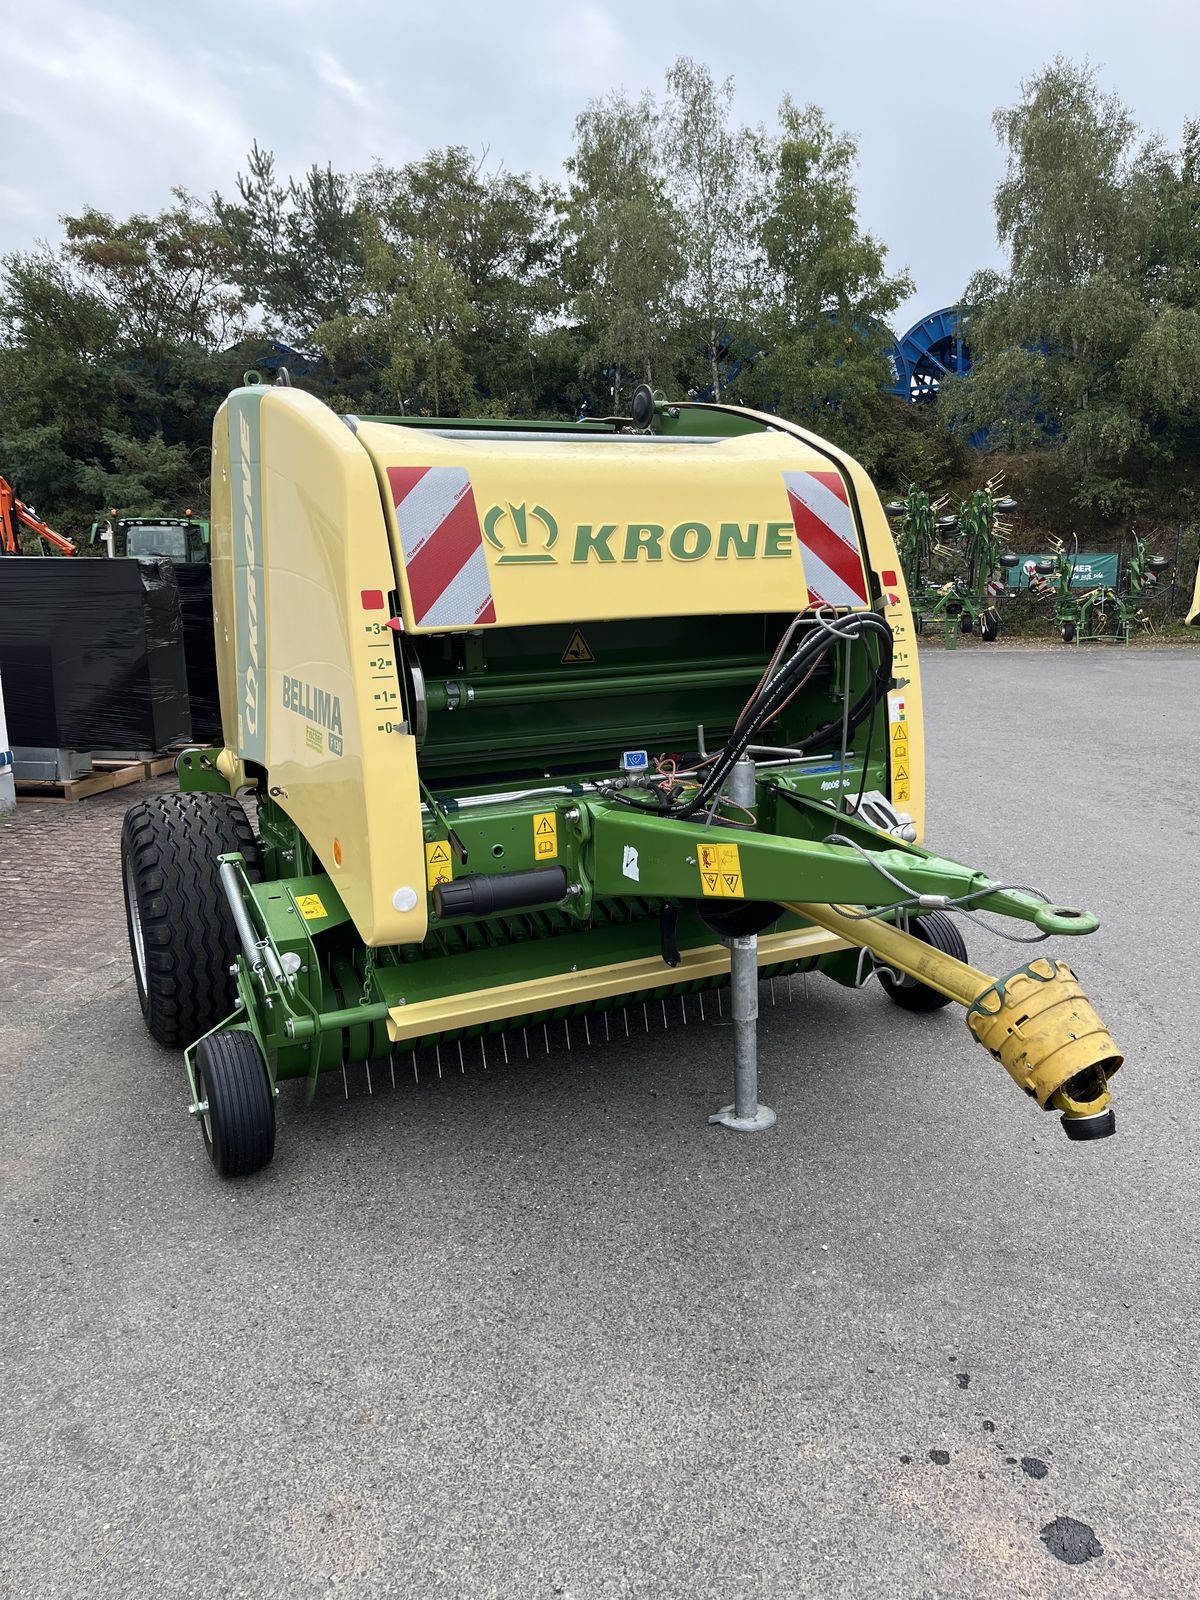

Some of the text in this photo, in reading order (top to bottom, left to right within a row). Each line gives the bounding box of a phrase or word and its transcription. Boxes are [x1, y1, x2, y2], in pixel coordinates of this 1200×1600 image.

[240, 410, 259, 670] KRONE
[571, 522, 794, 563] KRONE
[373, 623, 381, 635] 3
[894, 625, 900, 635] 2
[377, 658, 386, 670] 2
[382, 691, 389, 702] 1
[283, 675, 342, 736] BELLIMA
[385, 722, 393, 734] 0
